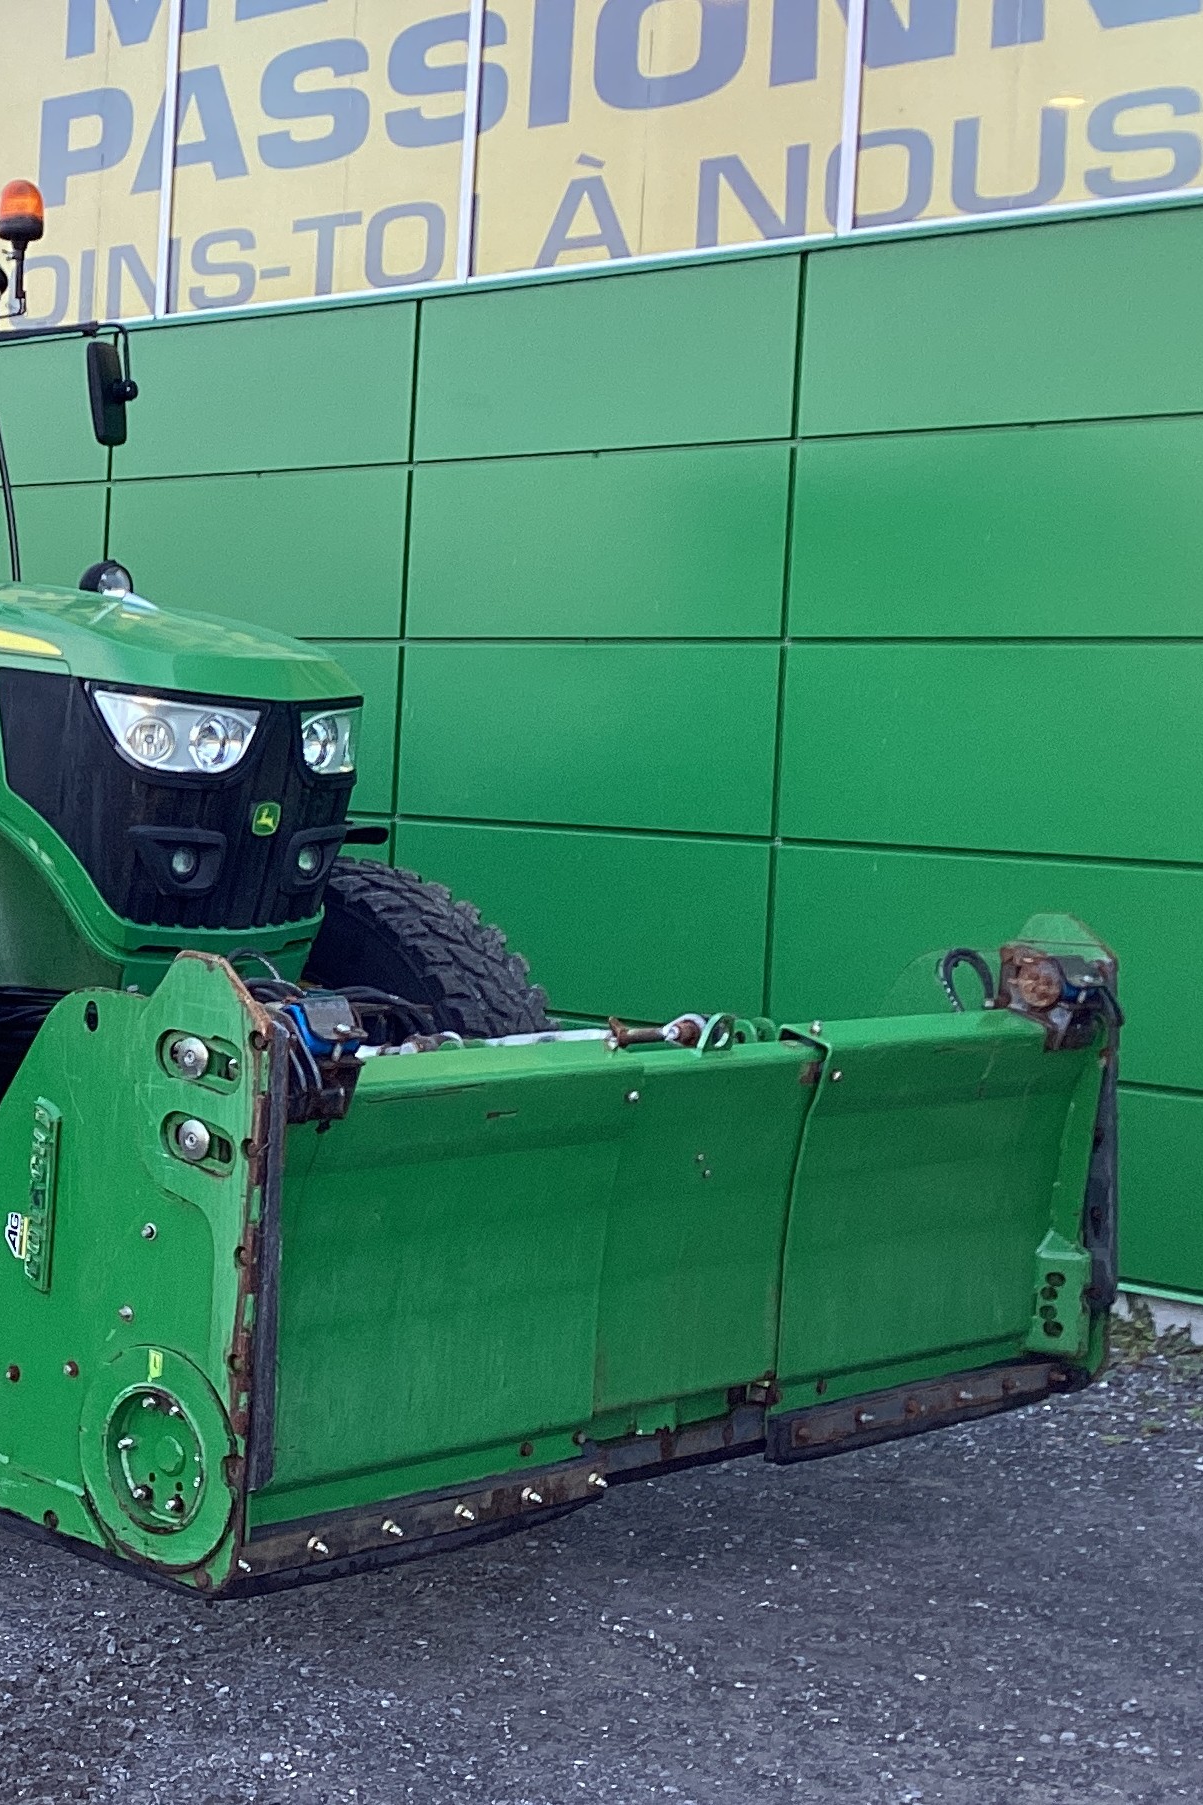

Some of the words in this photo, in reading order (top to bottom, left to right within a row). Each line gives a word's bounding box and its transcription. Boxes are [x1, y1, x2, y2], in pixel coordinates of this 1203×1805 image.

[38, 0, 1203, 208] PASSION
[534, 153, 634, 270] À
[696, 86, 1203, 249] NOUS
[7, 1213, 19, 1252] AG
